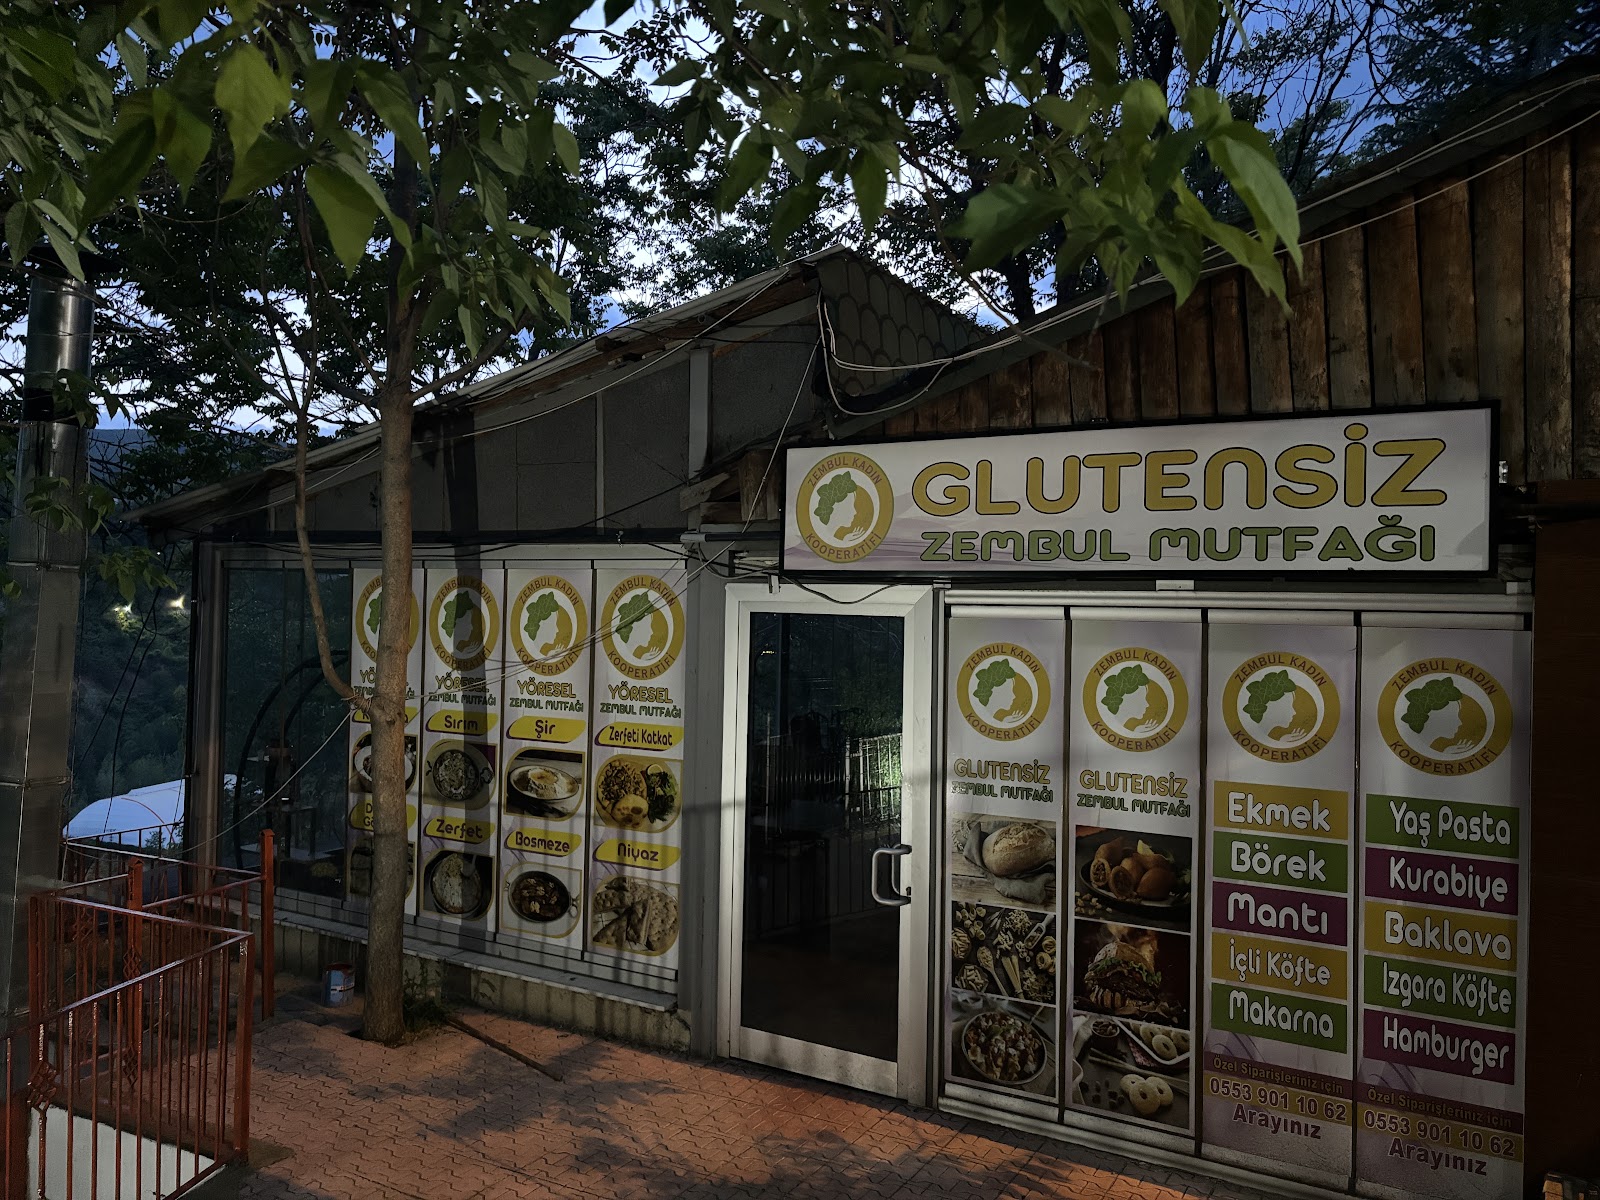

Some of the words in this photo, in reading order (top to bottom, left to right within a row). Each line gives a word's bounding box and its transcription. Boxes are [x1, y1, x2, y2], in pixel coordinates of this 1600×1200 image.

[808, 456, 848, 487] ZEMBUL
[852, 457, 882, 485] KADIN
[911, 422, 1448, 517] GLUTENSİZ
[806, 531, 882, 560] KOOPERATİFİ
[919, 528, 1131, 562] ZEMBUL
[1149, 515, 1436, 562] MUTFAĞI
[437, 577, 466, 603] ZEMBUL
[518, 577, 552, 606] ZEMBUL
[555, 578, 579, 606] KADIN
[610, 577, 646, 606] ZEMBUL
[607, 651, 676, 678] KOOPERATİFİ
[966, 645, 1007, 671] ZEMBUL
[1010, 646, 1041, 674] KADIN
[1094, 650, 1139, 677] ZEMBUL
[1143, 651, 1177, 681] KADIN
[1234, 654, 1284, 683] ZEMBUL
[1290, 656, 1327, 687] KADIN
[517, 677, 576, 698] YÖRESEL
[608, 681, 673, 704] YÖRESEL
[1391, 661, 1449, 691] ZEMBUL
[1455, 663, 1498, 695] KADIN
[509, 698, 543, 710] ZEMBUL
[545, 700, 584, 713] MUTFAĞI
[600, 702, 636, 715] ZEMBUL
[639, 705, 682, 718] MUTFAĞI
[534, 719, 556, 739] Şir
[609, 726, 640, 745] Zerfeti
[965, 712, 1041, 740] KOOPERATİFİ
[1092, 721, 1177, 751] KOOPERATİFİ
[1233, 730, 1327, 760] KOOPERATİFİ
[1388, 740, 1498, 774] KOOPERATİFİ
[954, 758, 1050, 784] GLUTENSİZ
[1079, 769, 1189, 799] GLUTENSİZ
[1001, 785, 1053, 803] MUTFAĞI
[1076, 793, 1128, 812] ZEMBUL
[1132, 799, 1191, 818] MUTFAĞI
[1227, 791, 1331, 832] Ekmek
[1389, 800, 1431, 848] Yaş
[1438, 805, 1511, 845] Pasta
[436, 819, 483, 839] Zerfet
[617, 843, 659, 862] Niyaz
[1230, 840, 1327, 882] Börek
[1388, 855, 1509, 908] Kurabiye
[1227, 890, 1328, 935] Mantı
[1384, 910, 1512, 961] Baklava
[1229, 937, 1261, 982] İçli
[1266, 950, 1331, 987] Köfte
[1382, 961, 1446, 1007] Izgara
[1451, 972, 1512, 1017] Köfte
[1228, 989, 1334, 1039] Makarna
[1383, 1015, 1510, 1076] Hamburger
[1213, 1055, 1238, 1072] Özel
[1241, 1062, 1318, 1089] Siparişleriniz
[1320, 1080, 1344, 1095] için
[1210, 1077, 1252, 1101] 0553
[1257, 1087, 1289, 1110] 901
[1296, 1095, 1318, 1115] 10
[1324, 1101, 1347, 1122] 62
[1368, 1086, 1395, 1105] Özel
[1486, 1111, 1513, 1128] için
[1233, 1103, 1321, 1140] Arayınız
[1363, 1110, 1411, 1135] 0553
[1416, 1120, 1451, 1144] 901
[1459, 1128, 1484, 1150] 10
[1490, 1135, 1515, 1157] 62
[1388, 1137, 1487, 1176] Arayınız
